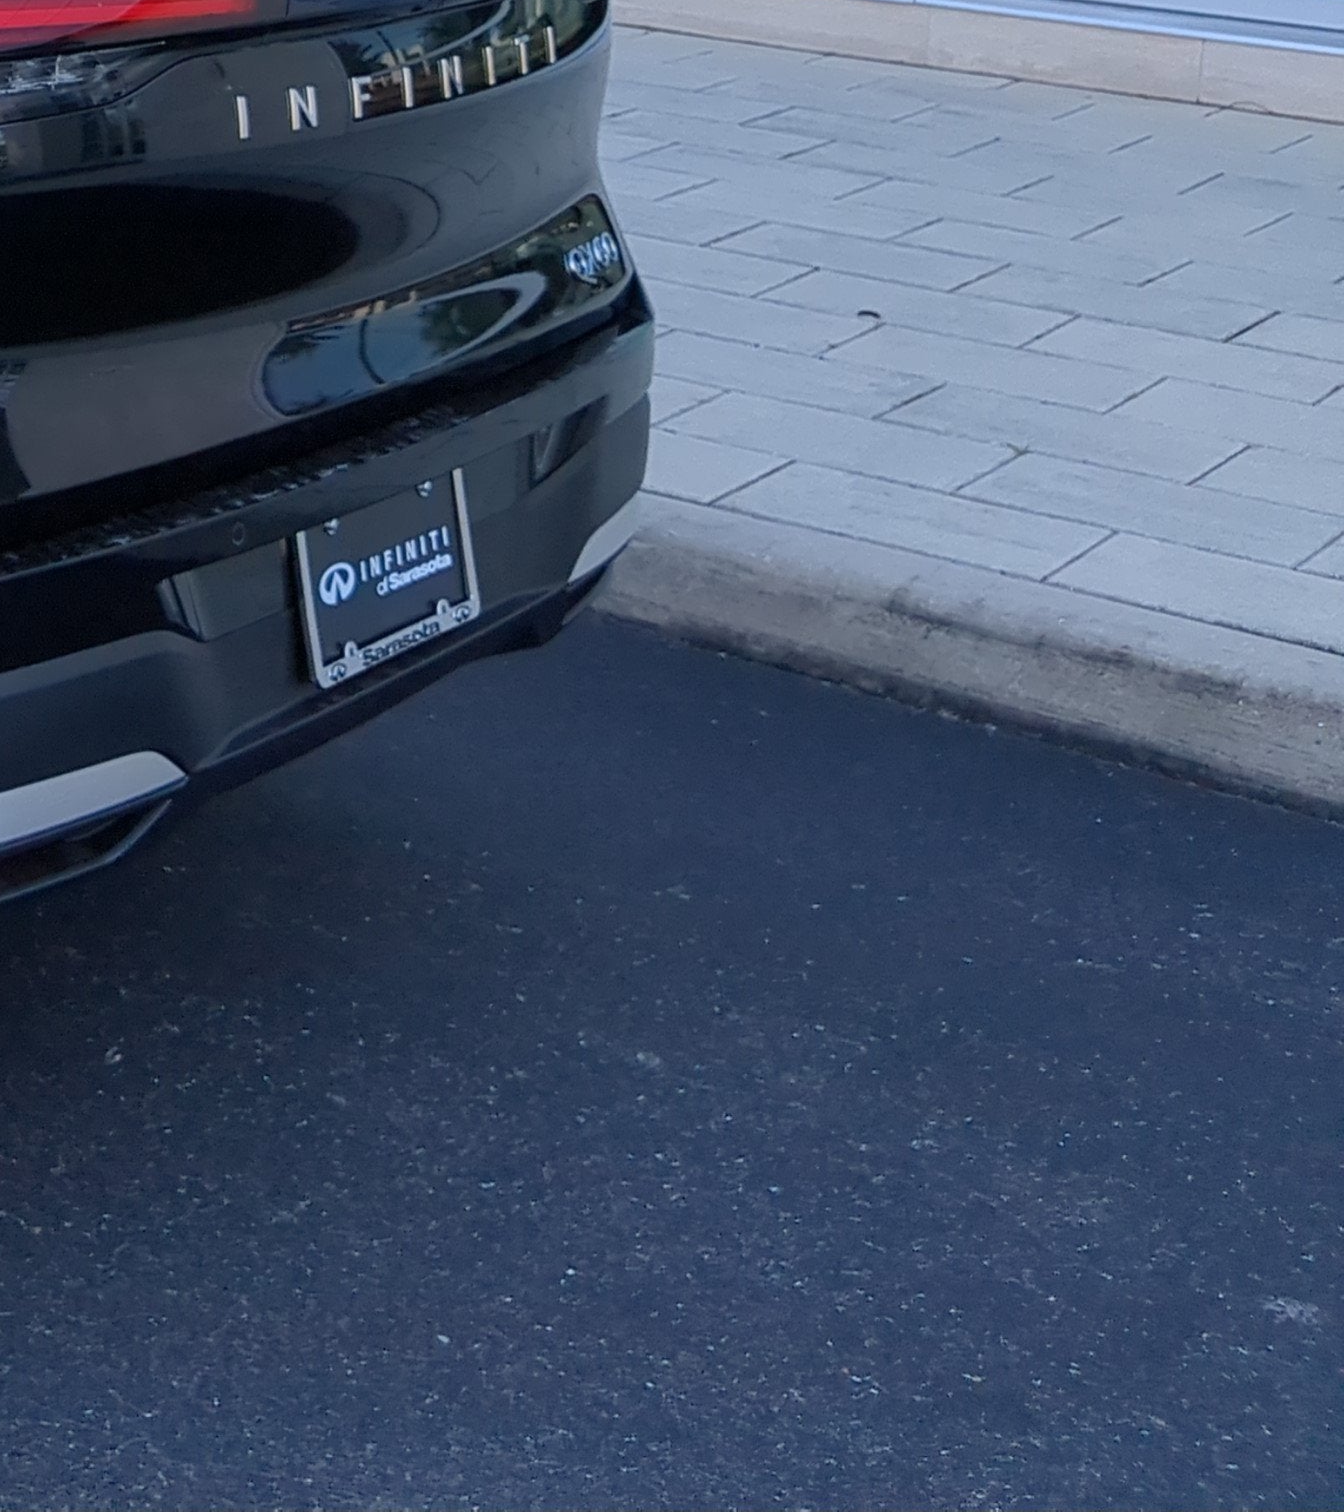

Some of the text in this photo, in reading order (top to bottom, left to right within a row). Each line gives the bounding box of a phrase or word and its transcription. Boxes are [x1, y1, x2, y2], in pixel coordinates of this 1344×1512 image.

[235, 24, 557, 141] INFINITI
[359, 525, 451, 582] INFINITI
[389, 553, 454, 591] Sarasota
[362, 619, 440, 666] Sarasota
